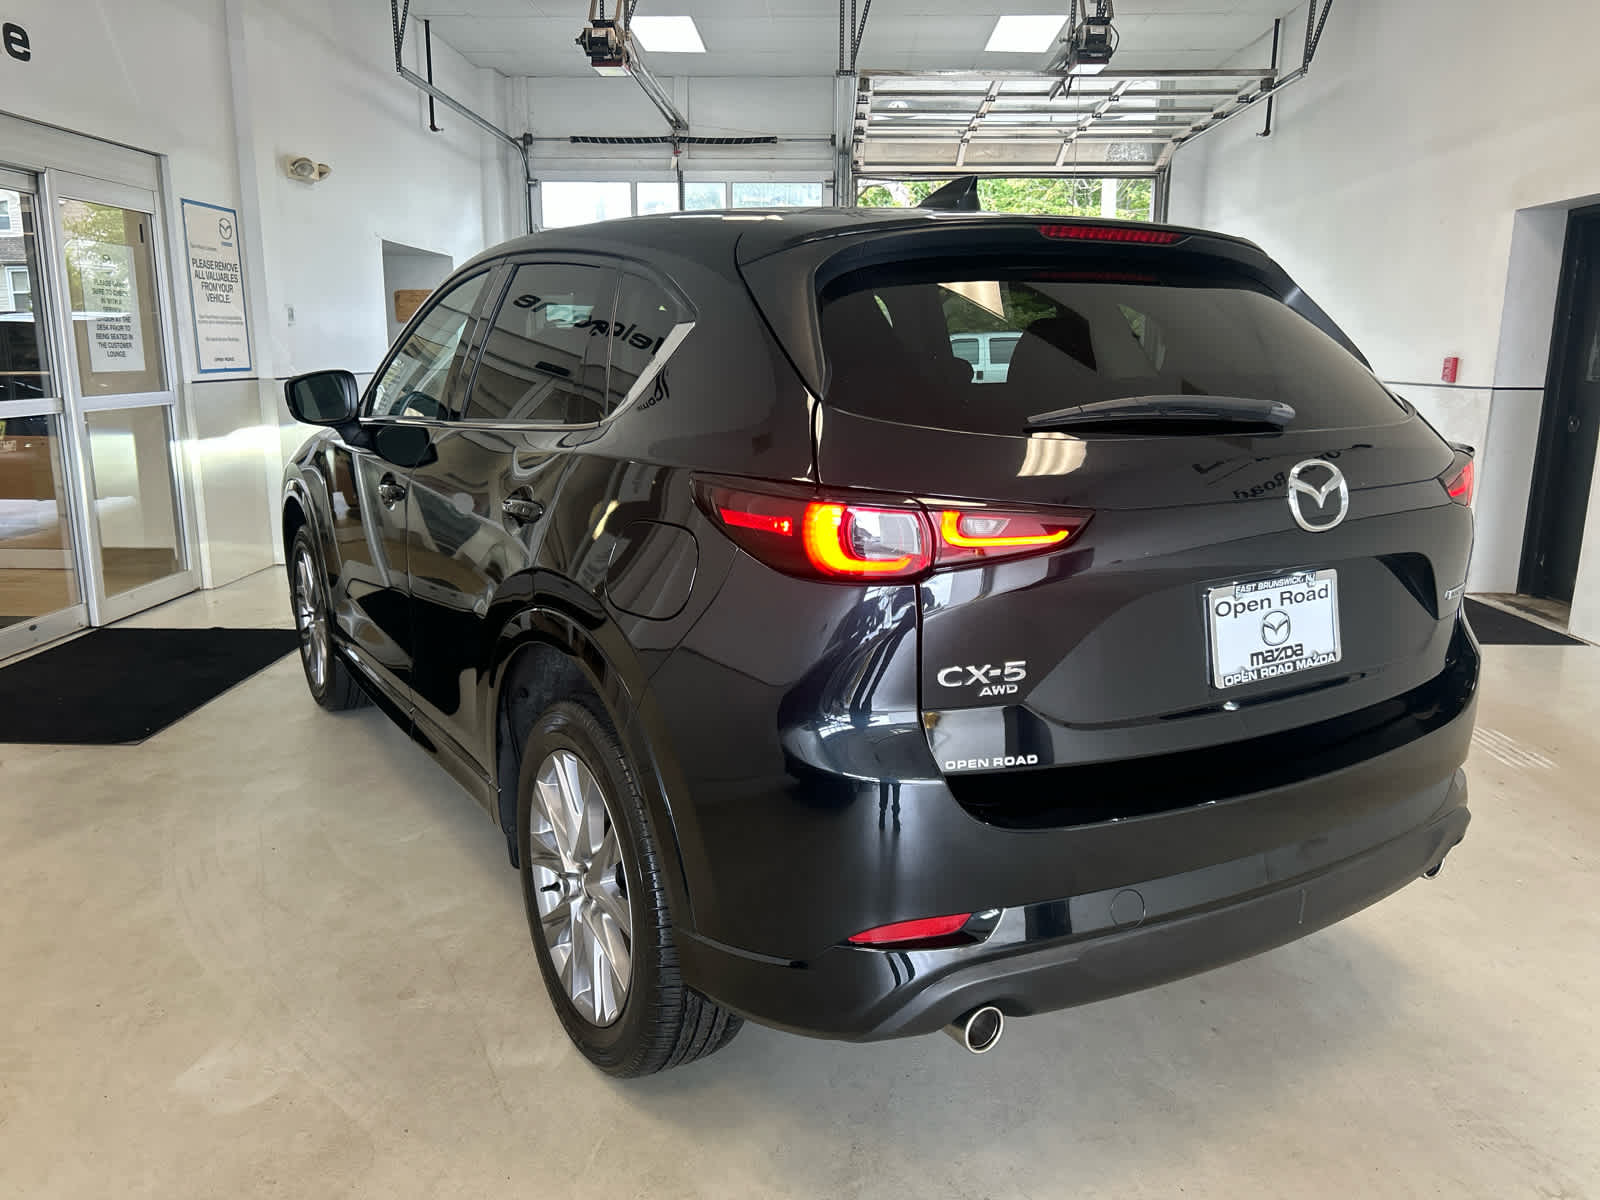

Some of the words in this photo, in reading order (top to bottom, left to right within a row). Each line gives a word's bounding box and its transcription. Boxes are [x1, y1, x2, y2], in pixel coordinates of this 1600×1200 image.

[2, 22, 31, 62] e
[191, 257, 214, 270] PLEASE
[215, 260, 239, 273] REMOVE
[194, 269, 206, 280] ALL
[206, 271, 239, 283] VALUABLES
[201, 281, 217, 292] FROM
[217, 283, 234, 293] YOUR
[1235, 583, 1256, 595] EAST
[1215, 597, 1272, 618] Open
[1280, 584, 1329, 606] Road
[937, 660, 1026, 687] CX-5
[1224, 670, 1258, 686] OPEN
[1260, 662, 1293, 678] ROAD
[1295, 653, 1336, 670] MAZDA
[979, 684, 1018, 697] AWD
[945, 758, 990, 770] OPEN
[993, 754, 1039, 768] ROAD
